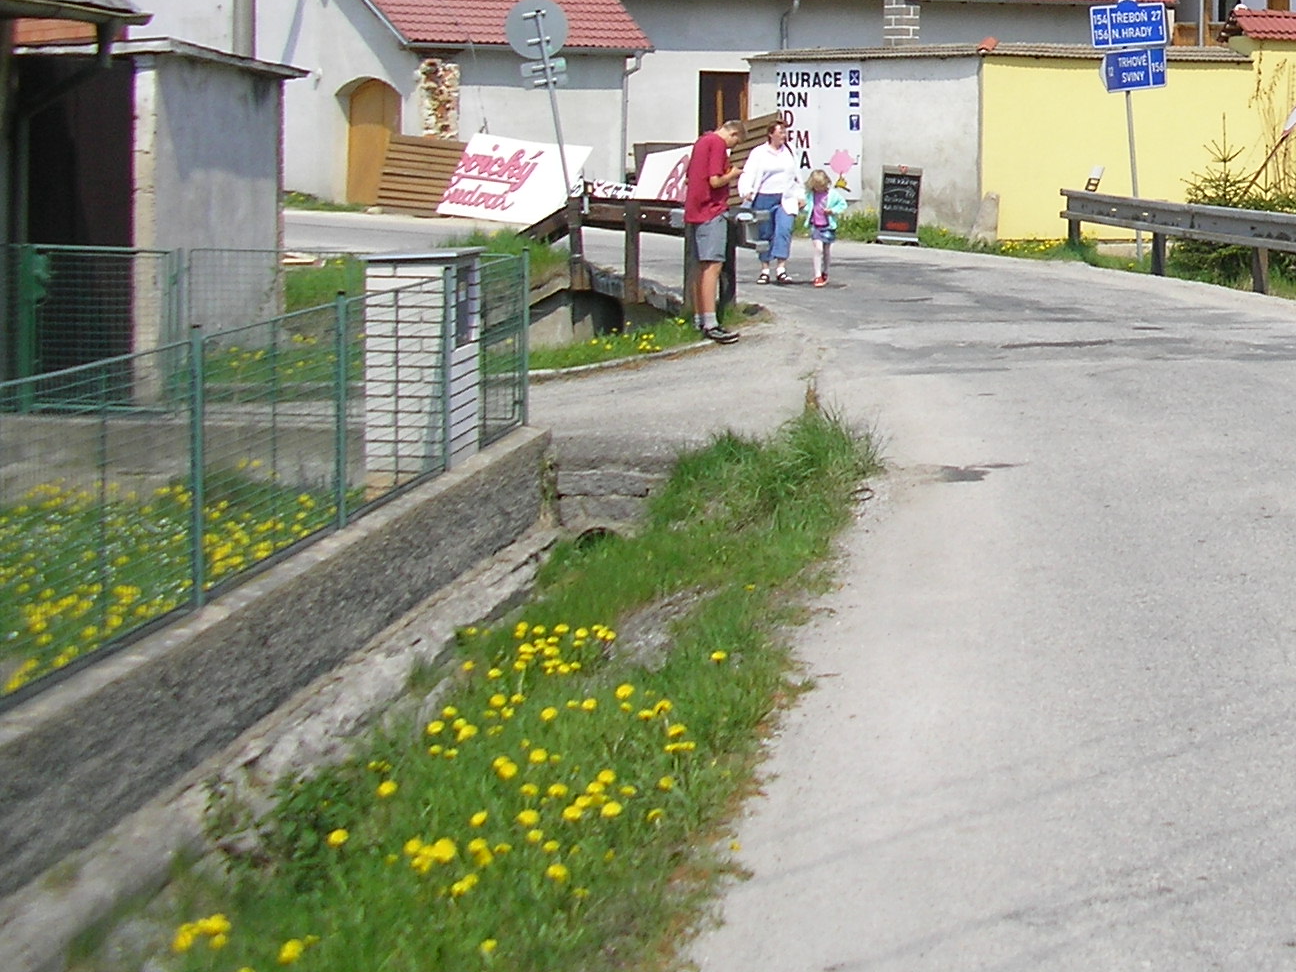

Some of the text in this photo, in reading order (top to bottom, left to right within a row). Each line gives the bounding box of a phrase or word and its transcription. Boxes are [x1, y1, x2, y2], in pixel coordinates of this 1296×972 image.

[1093, 9, 1161, 25] 154 TŘEBOŇ 27
[1159, 25, 1163, 35] 1
[776, 70, 842, 88] AURACE
[1122, 71, 1145, 83] SVINY
